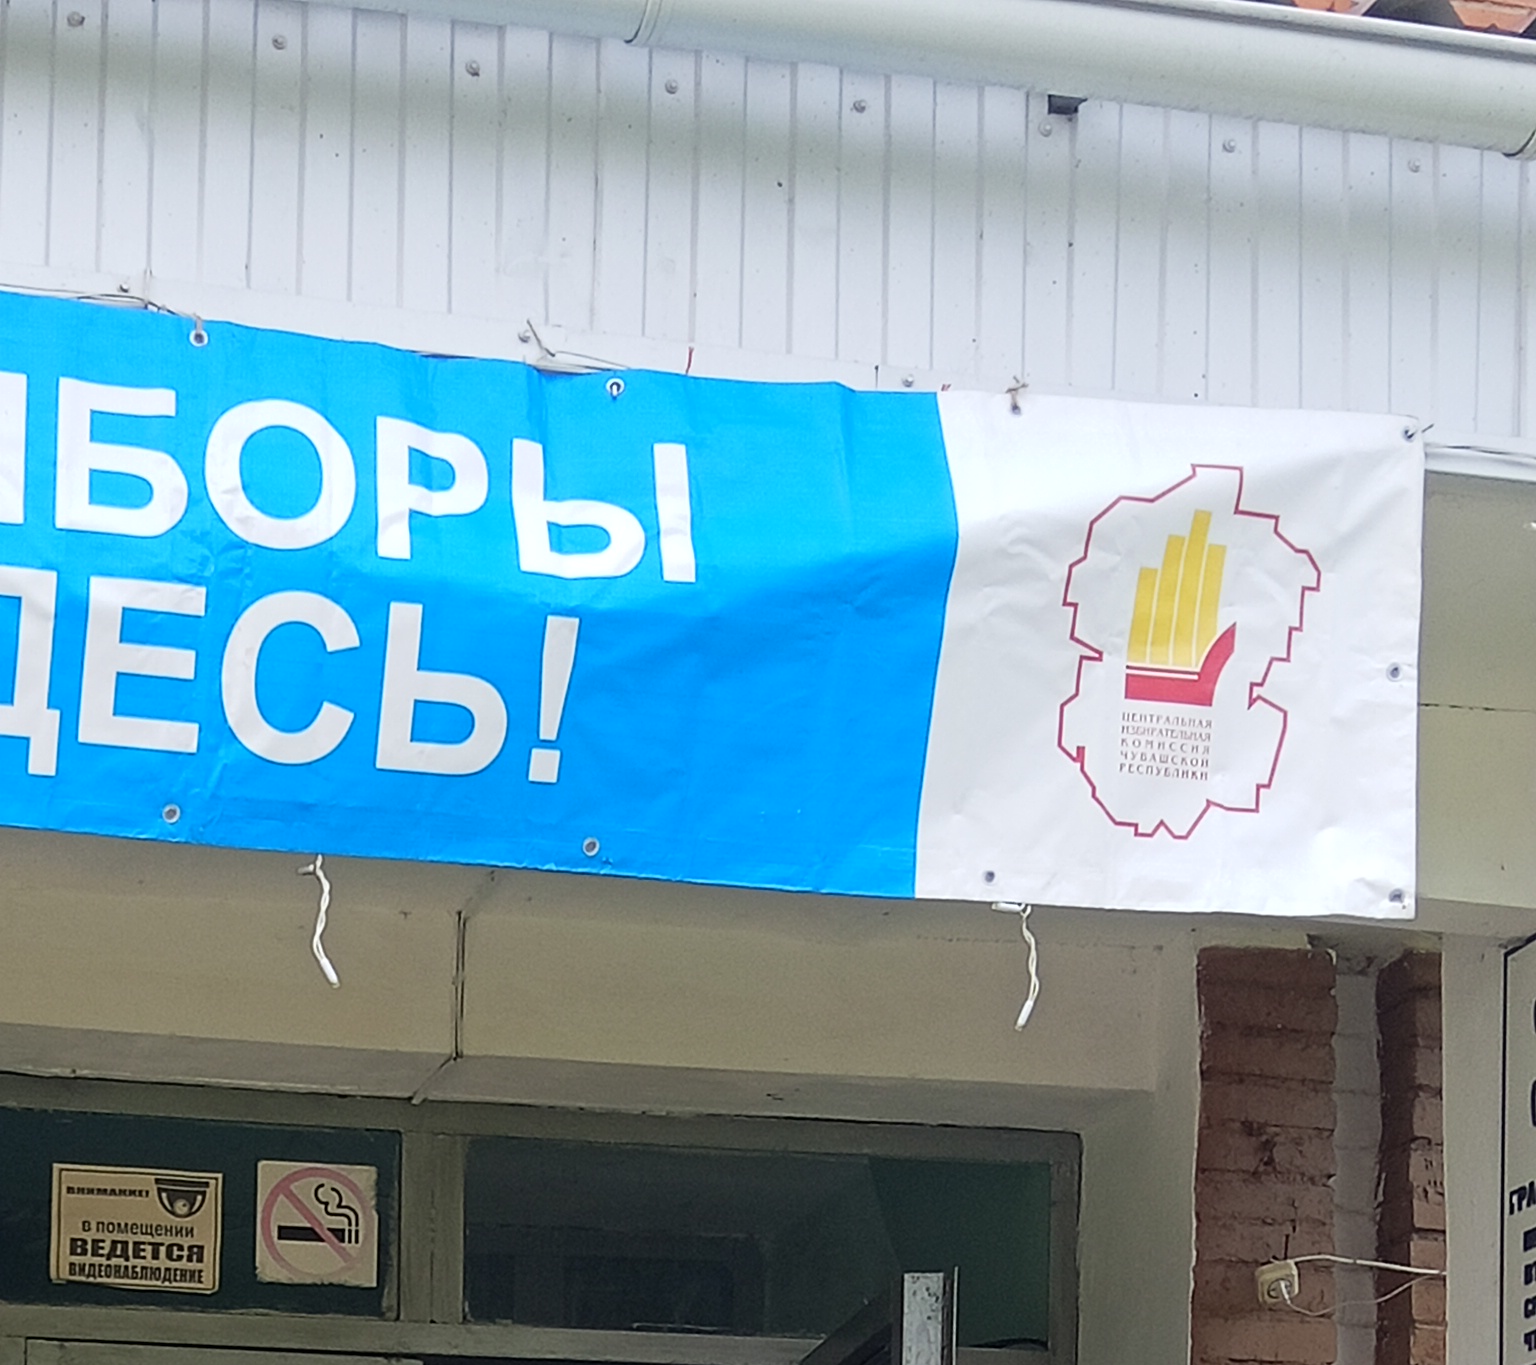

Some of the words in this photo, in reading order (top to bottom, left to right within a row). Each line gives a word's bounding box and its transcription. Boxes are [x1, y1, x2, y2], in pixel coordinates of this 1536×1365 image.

[1122, 712, 1212, 728] ЦЕНТРАЛЬНАЯ
[1121, 725, 1211, 742] ИЗБИРАТЕЛЬНАЯ
[1120, 738, 1210, 755] КОМИССИЯ
[1119, 763, 1208, 780] РЕСПУБЛИКИ
[65, 1185, 150, 1199] ВНИМАНИЕ!
[96, 1222, 194, 1239] помещении
[68, 1237, 205, 1264] ВЕДЕТСЯ
[68, 1262, 204, 1284] ВИДЕОНАБЛЮДЕНИЕ
